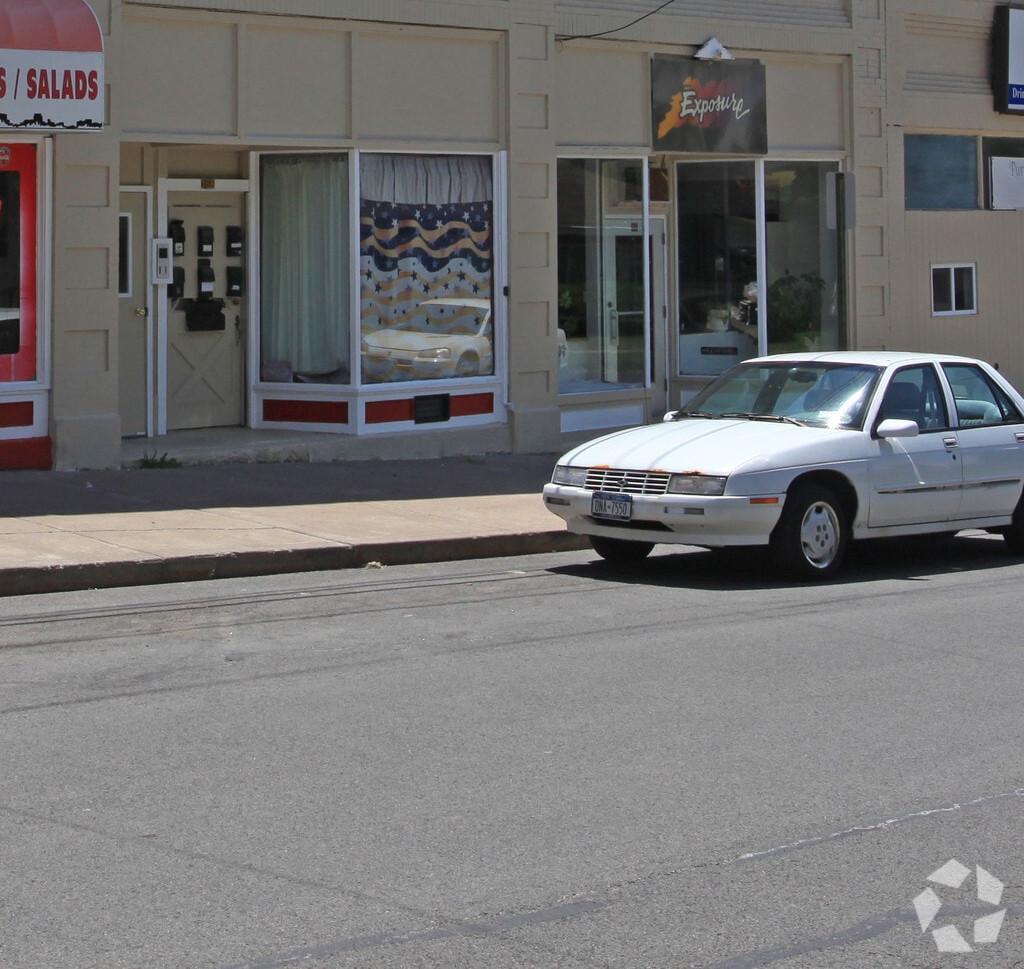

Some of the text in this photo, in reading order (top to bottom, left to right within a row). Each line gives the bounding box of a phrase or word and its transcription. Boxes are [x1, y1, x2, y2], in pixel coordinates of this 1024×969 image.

[13, 68, 20, 100] /
[26, 68, 99, 101] SALADS
[680, 91, 750, 122] Exposure
